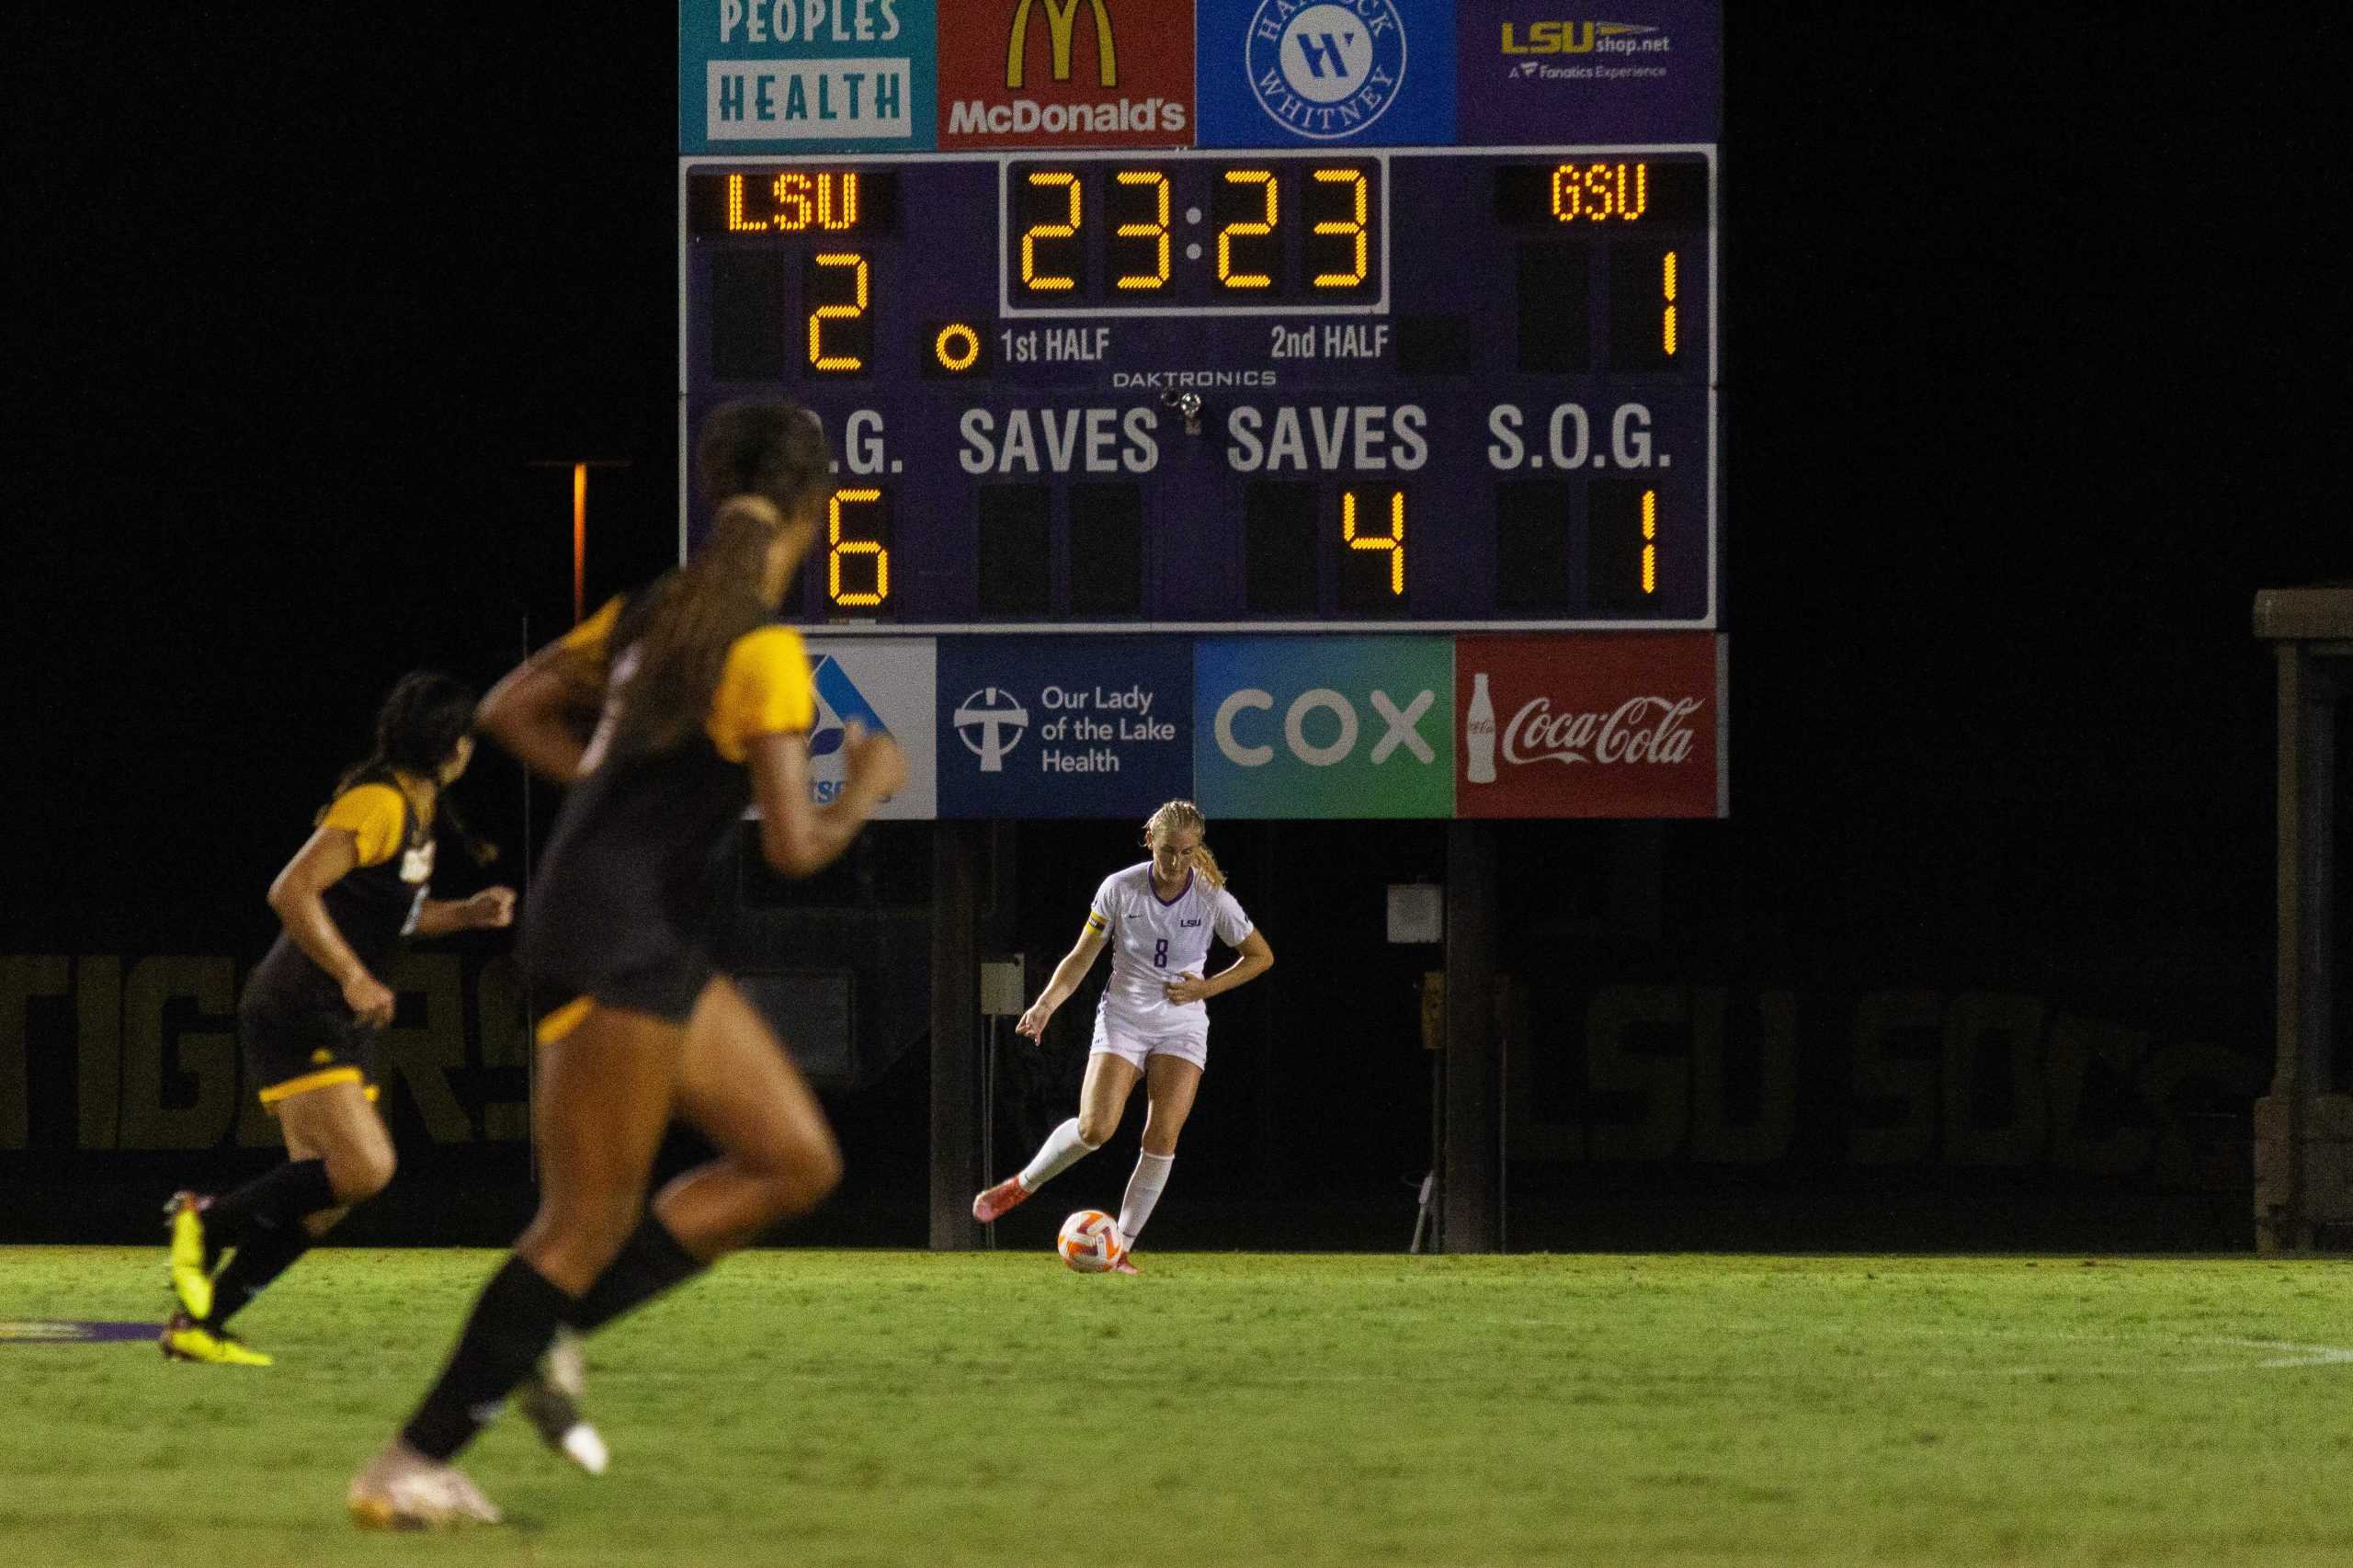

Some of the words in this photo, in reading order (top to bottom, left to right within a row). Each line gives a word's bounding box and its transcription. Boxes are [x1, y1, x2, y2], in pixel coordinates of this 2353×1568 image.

[720, 0, 901, 43] PEOPLES
[1257, 0, 1394, 42] HACK
[1501, 21, 1595, 54] LSU
[1596, 37, 1669, 55] shop.net
[720, 73, 901, 121] HEALTH
[1260, 64, 1393, 130] WHITNEY
[1540, 65, 1593, 79] Fanatics
[1596, 66, 1666, 80] Experience
[949, 97, 1186, 133] McDonald's
[729, 173, 857, 231] LSU
[1552, 164, 1645, 222] GSU
[1022, 170, 1367, 290] 23:23
[810, 254, 868, 371] 2
[1664, 251, 1677, 356] 1
[1001, 329, 1038, 361] 1st
[1045, 328, 1110, 359] HALF
[1271, 326, 1315, 358] 2nd
[1324, 325, 1389, 358] HALF
[1113, 370, 1277, 388] DAKTRONICS
[959, 407, 1160, 475] SAVES
[1227, 404, 1428, 472] SAVES
[1487, 403, 1672, 470] S.O.G.
[829, 489, 888, 607] 6
[1343, 492, 1404, 596] 4
[1642, 490, 1655, 595] 1
[1041, 687, 1087, 710] Our
[1095, 686, 1154, 714] Lady
[1041, 718, 1067, 741] of
[1074, 719, 1115, 741] the
[1120, 719, 1176, 741] Lake
[1213, 688, 1436, 767] COX
[1502, 697, 1706, 765] Coca-Cola
[1041, 748, 1120, 774] Health
[1180, 918, 1201, 927] LSU
[1154, 938, 1169, 968] 8
